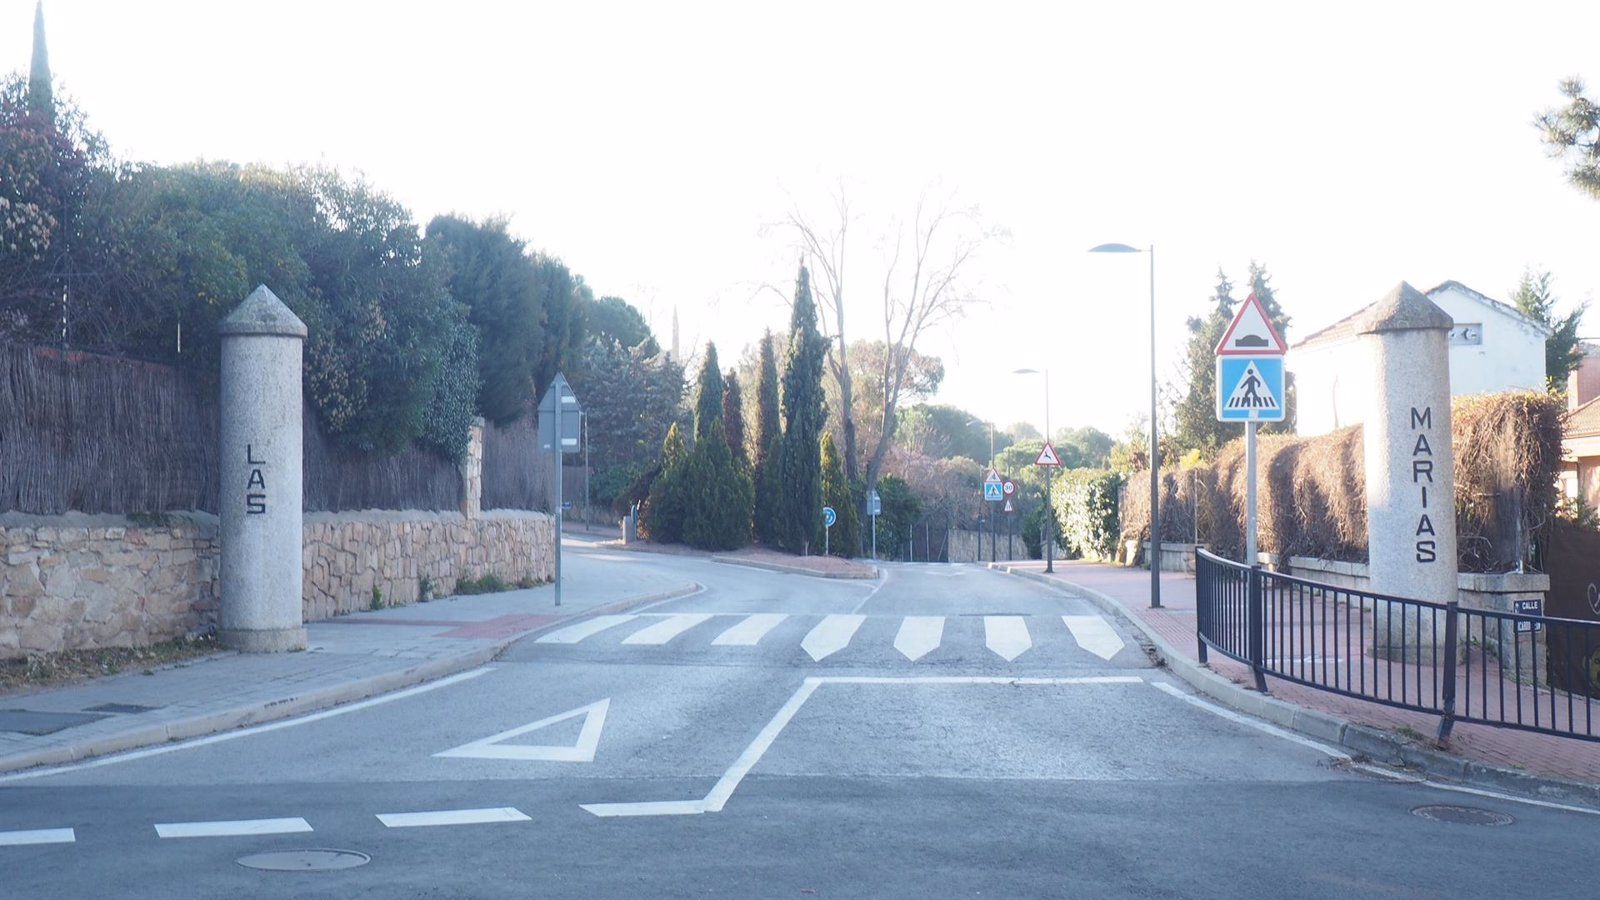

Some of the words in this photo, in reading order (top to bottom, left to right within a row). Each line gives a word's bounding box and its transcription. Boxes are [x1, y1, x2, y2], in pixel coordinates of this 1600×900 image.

[246, 444, 266, 514] LAS
[1411, 407, 1436, 563] MARIAS
[1521, 601, 1538, 610] CALLE
